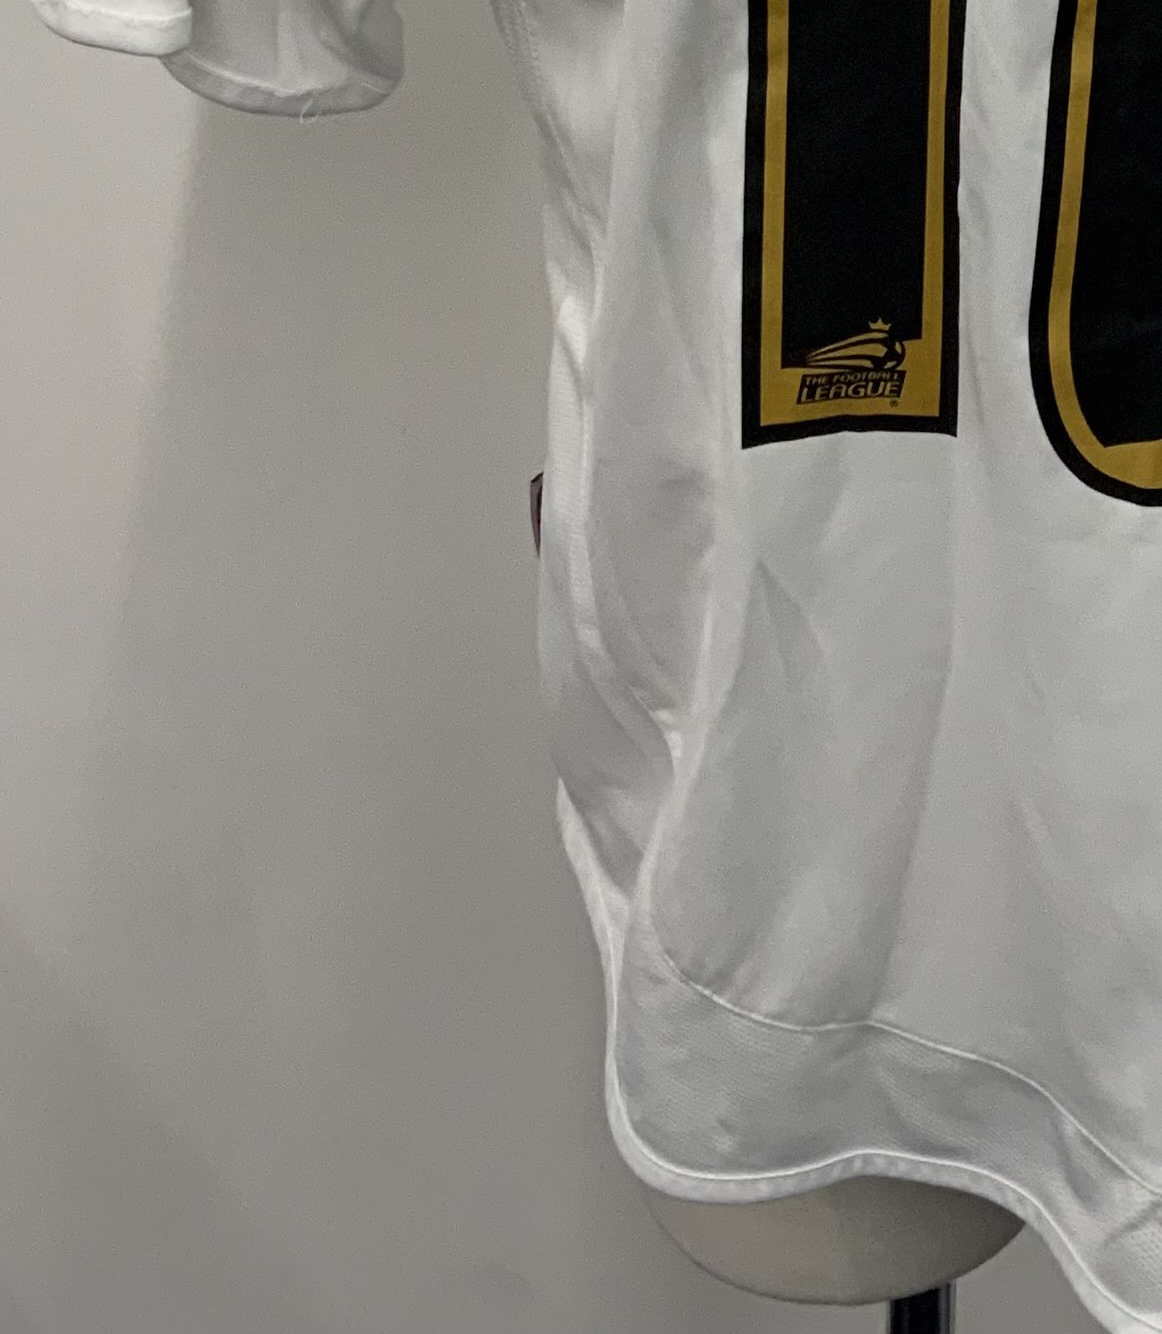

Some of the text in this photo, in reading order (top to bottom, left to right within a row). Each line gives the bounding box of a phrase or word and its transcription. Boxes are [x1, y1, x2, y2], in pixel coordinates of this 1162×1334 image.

[804, 369, 900, 386] THE FOOTBALL
[800, 381, 900, 403] LEAGUE
